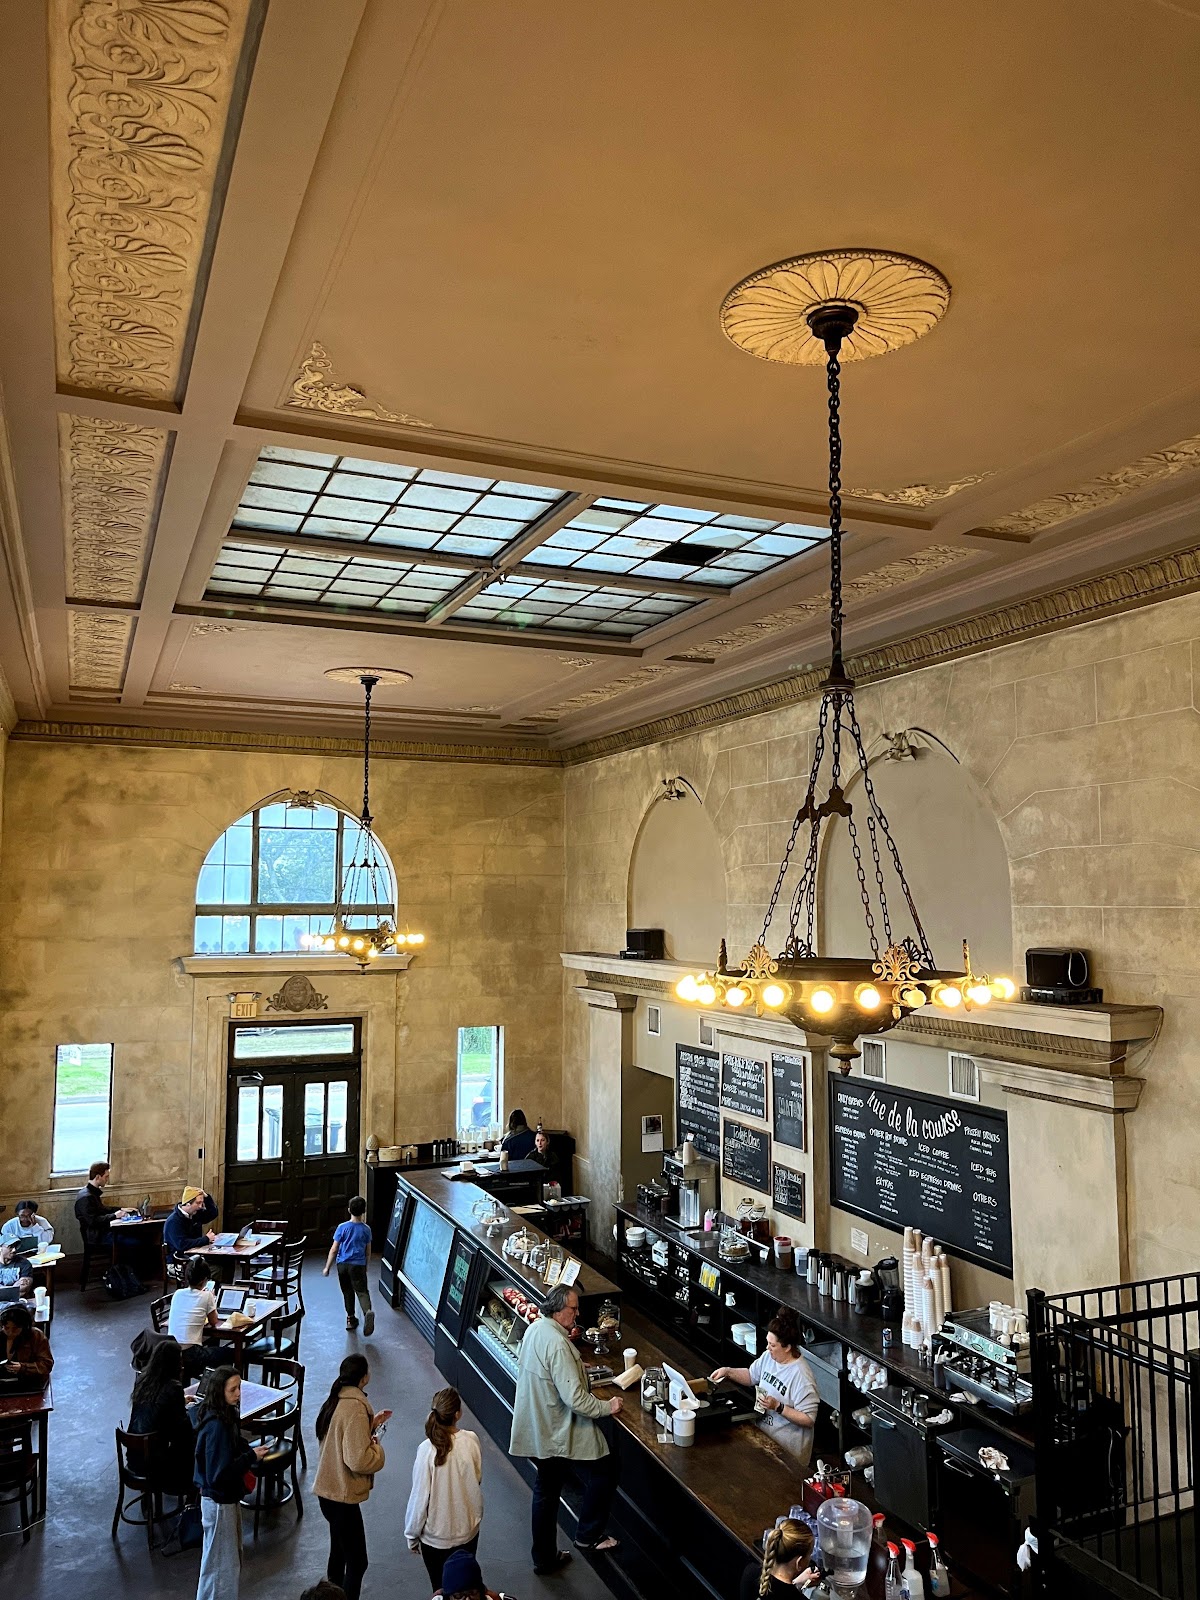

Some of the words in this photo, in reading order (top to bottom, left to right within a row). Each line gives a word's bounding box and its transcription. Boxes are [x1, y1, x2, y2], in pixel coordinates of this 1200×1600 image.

[235, 1003, 253, 1017] EXIT
[866, 1090, 886, 1120] rue
[887, 1100, 902, 1132] de
[905, 1106, 919, 1138] la
[922, 1109, 962, 1140] course
[869, 1127, 885, 1140] OTHER
[982, 1130, 1001, 1143] DRINKS
[918, 1142, 930, 1154] ICED
[932, 1147, 950, 1160] COFFEE
[970, 1161, 984, 1174] ICED
[875, 1176, 894, 1190] EXTRAS
[908, 1168, 920, 1178] ICED
[920, 1172, 943, 1186] ESPRESSO
[943, 1179, 963, 1193] DRINKS
[972, 1191, 998, 1207] OTHERS
